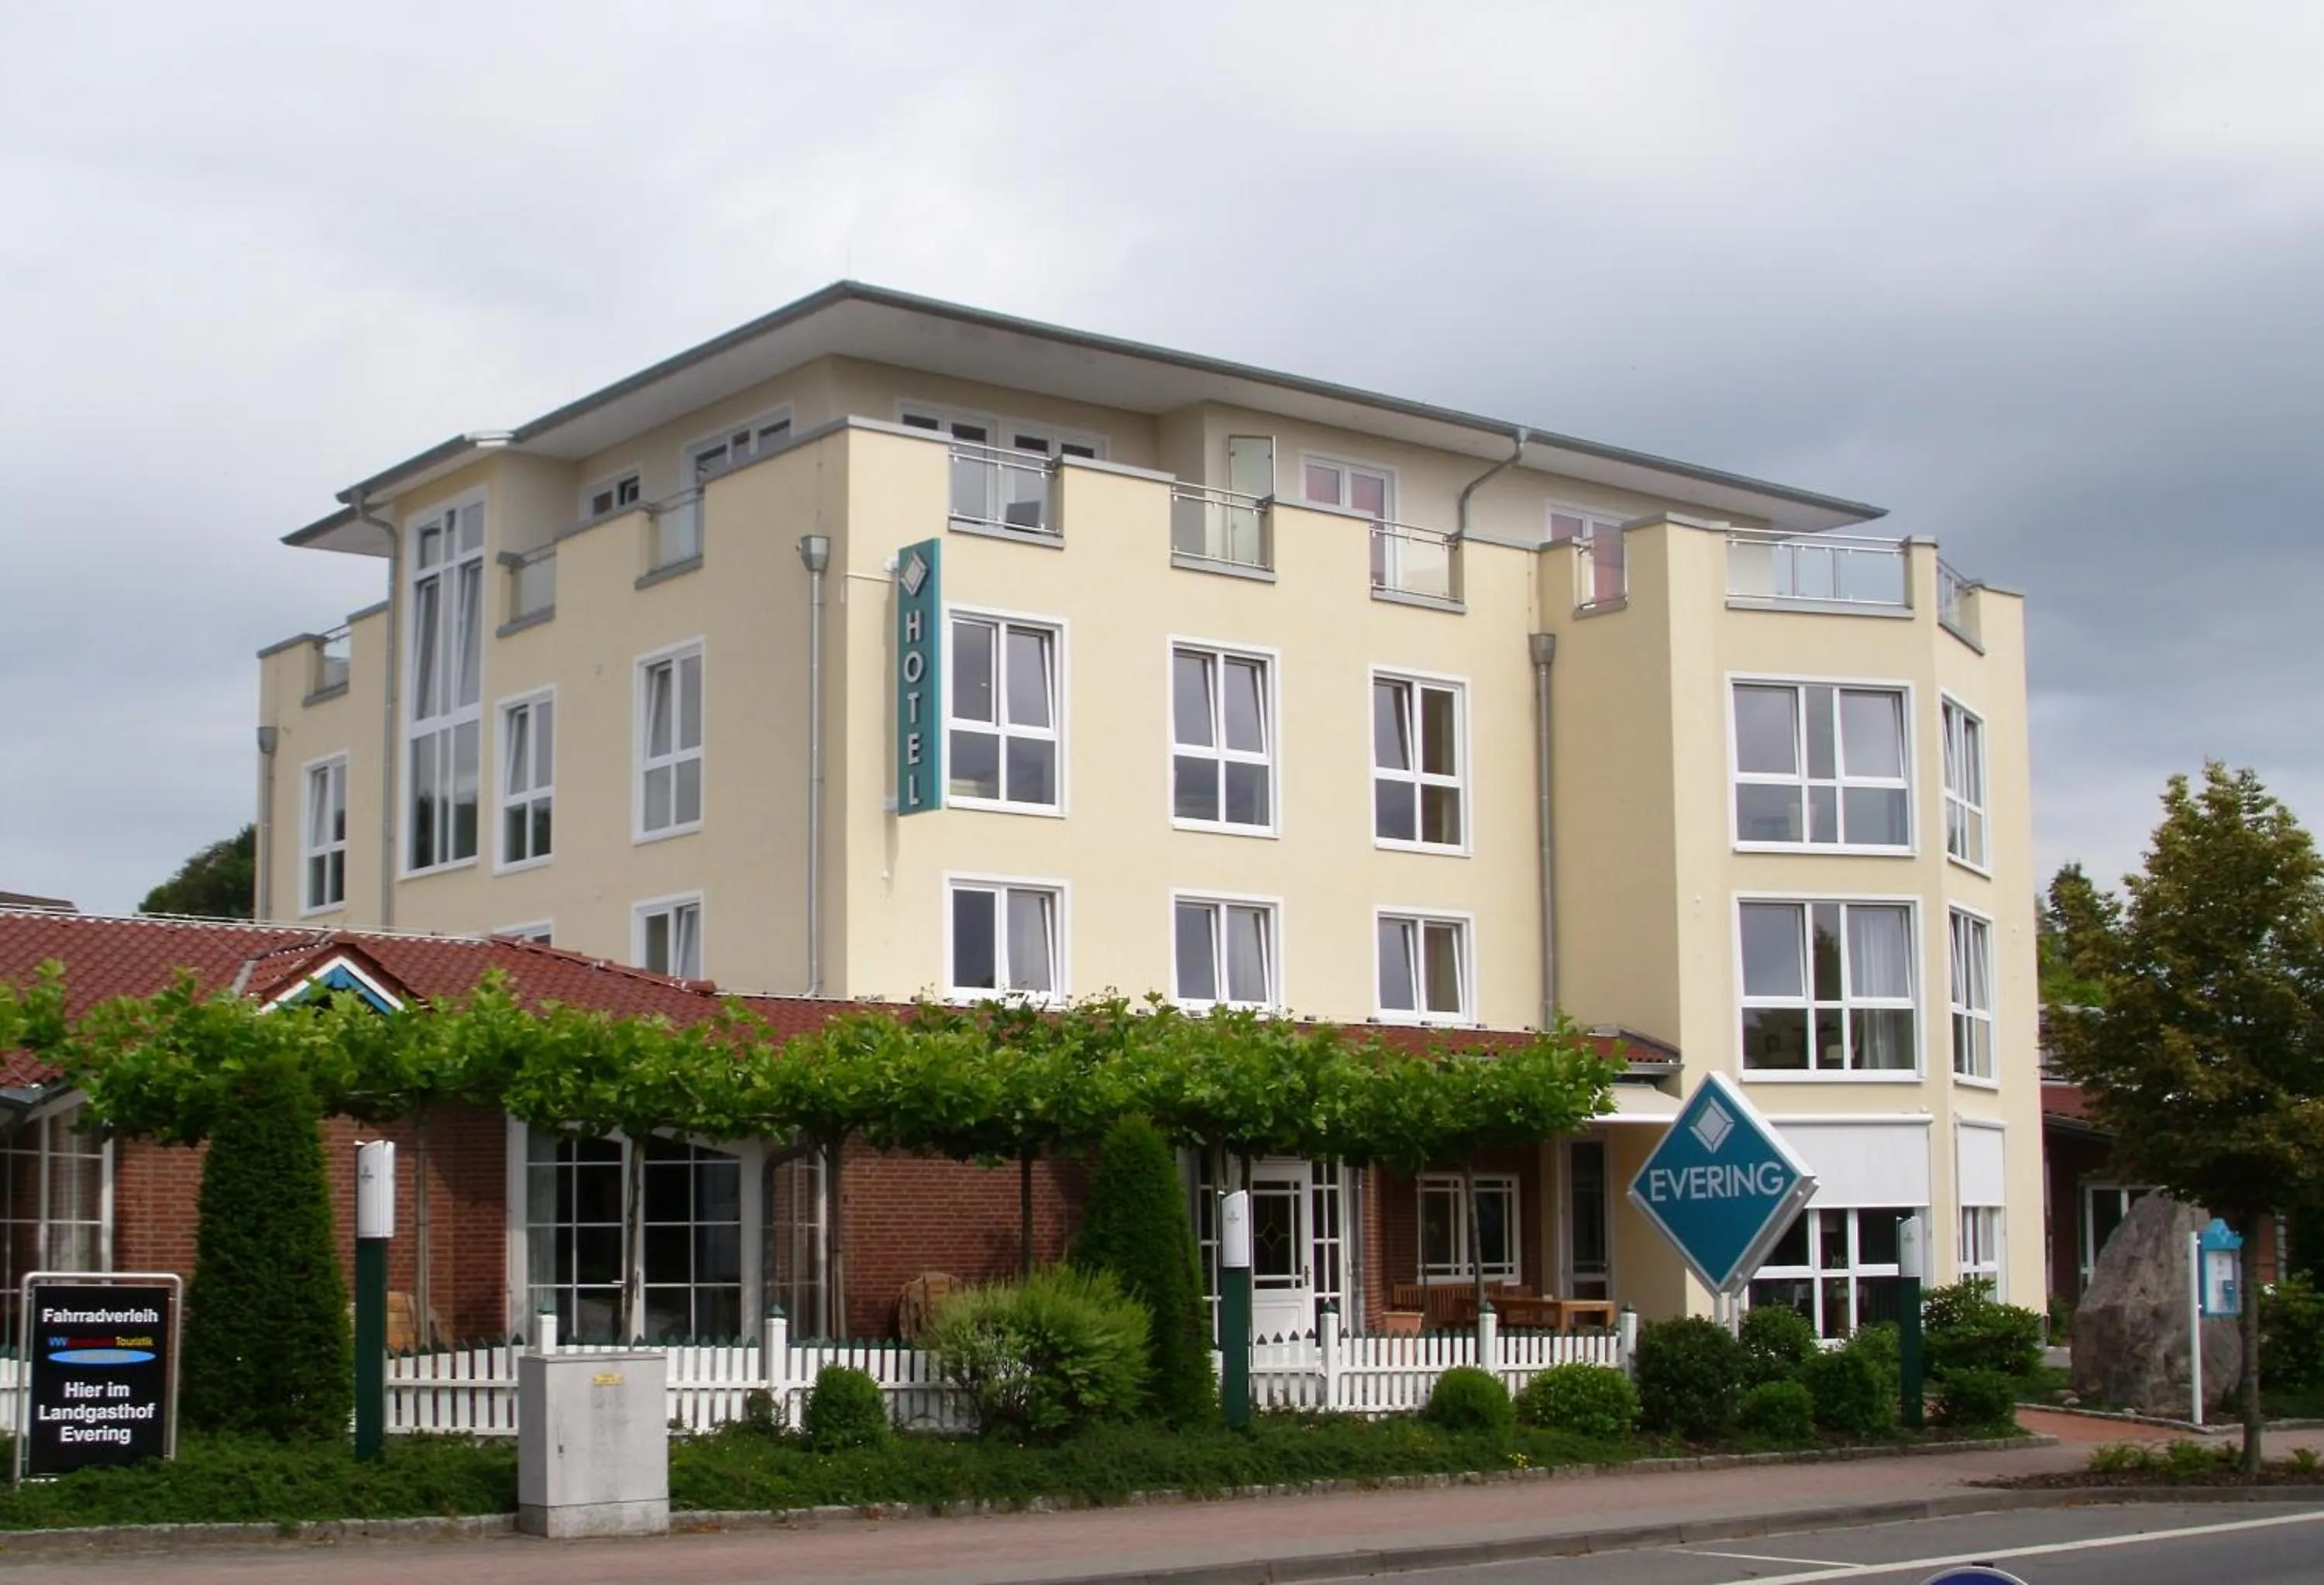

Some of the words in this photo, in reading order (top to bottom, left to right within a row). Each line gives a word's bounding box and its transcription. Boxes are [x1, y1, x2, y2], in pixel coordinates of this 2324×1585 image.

[904, 609, 926, 806] HOTEL
[1649, 1161, 1784, 1202] EVERING
[43, 1308, 158, 1322] Fahrradverleih
[64, 1382, 103, 1398] Hier
[108, 1382, 130, 1398] im
[39, 1403, 155, 1423] Landgasthof
[60, 1426, 131, 1444] Evering
